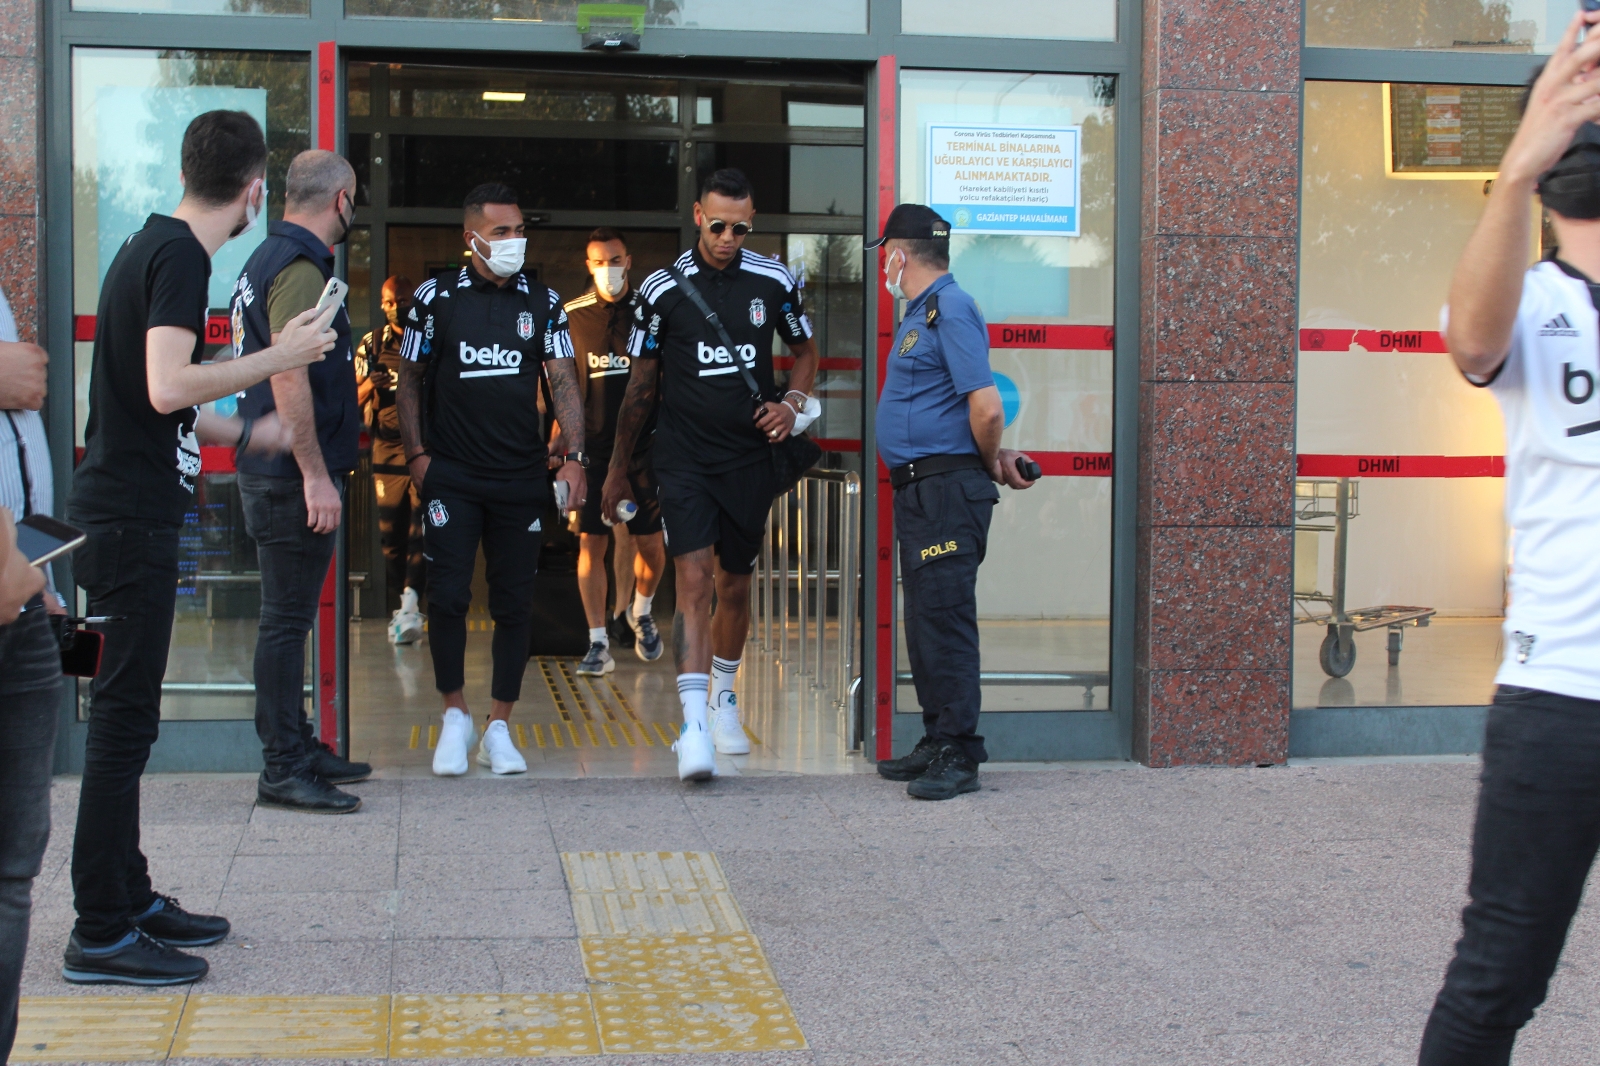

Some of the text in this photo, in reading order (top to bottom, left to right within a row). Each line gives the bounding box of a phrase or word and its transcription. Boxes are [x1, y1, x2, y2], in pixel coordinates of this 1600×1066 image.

[947, 140, 1061, 153] TERMİNAL BİNALARINA
[934, 153, 1073, 168] UĞURLAYICI VE KARŞILAYICI
[954, 170, 1053, 182] ALINMAMAKTADIR.
[994, 185, 1027, 194] kabiliyeti
[959, 193, 1049, 203] yolcu refakatçileri hariç)
[976, 211, 1068, 224] GAZİANTEP HAVALİMANI
[1002, 326, 1047, 343] DHMİ
[1380, 332, 1422, 348] DHMİ
[460, 341, 523, 367] beko
[587, 351, 631, 369] beko
[1073, 456, 1111, 471] DHM
[1358, 456, 1400, 473] DHMİ
